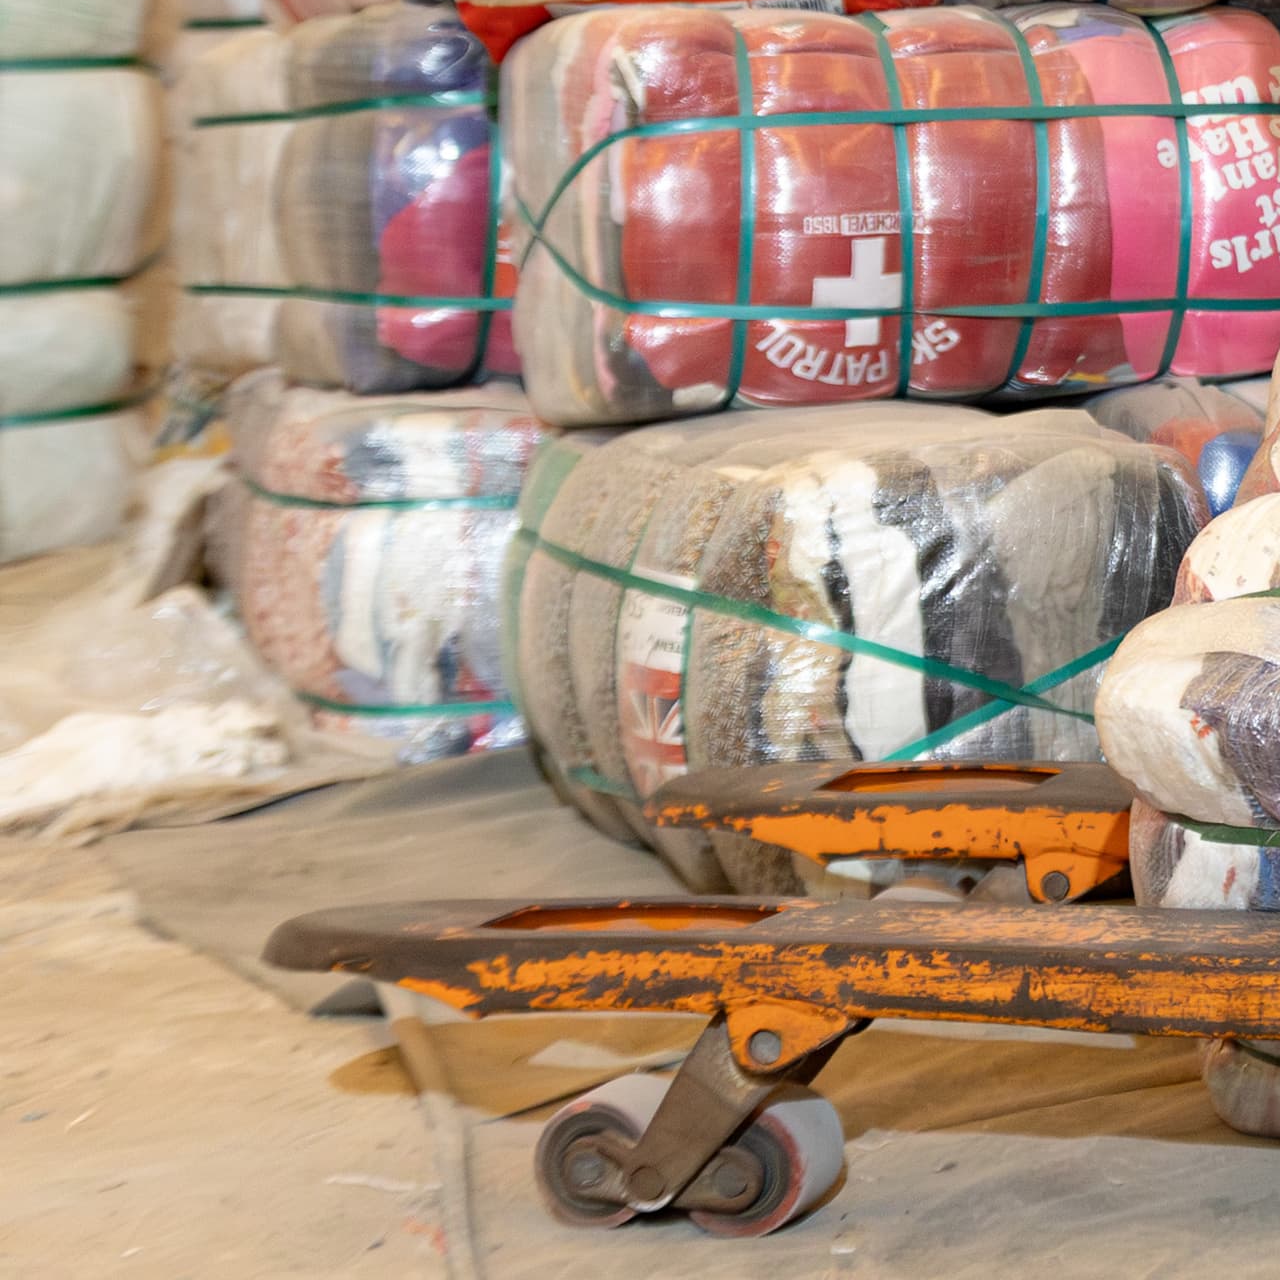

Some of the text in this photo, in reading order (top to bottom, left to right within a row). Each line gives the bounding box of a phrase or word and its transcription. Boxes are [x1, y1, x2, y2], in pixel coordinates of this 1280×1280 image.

[1156, 116, 1270, 170] Have
[803, 215, 840, 235] 1850
[755, 319, 961, 386] SK PATROL
